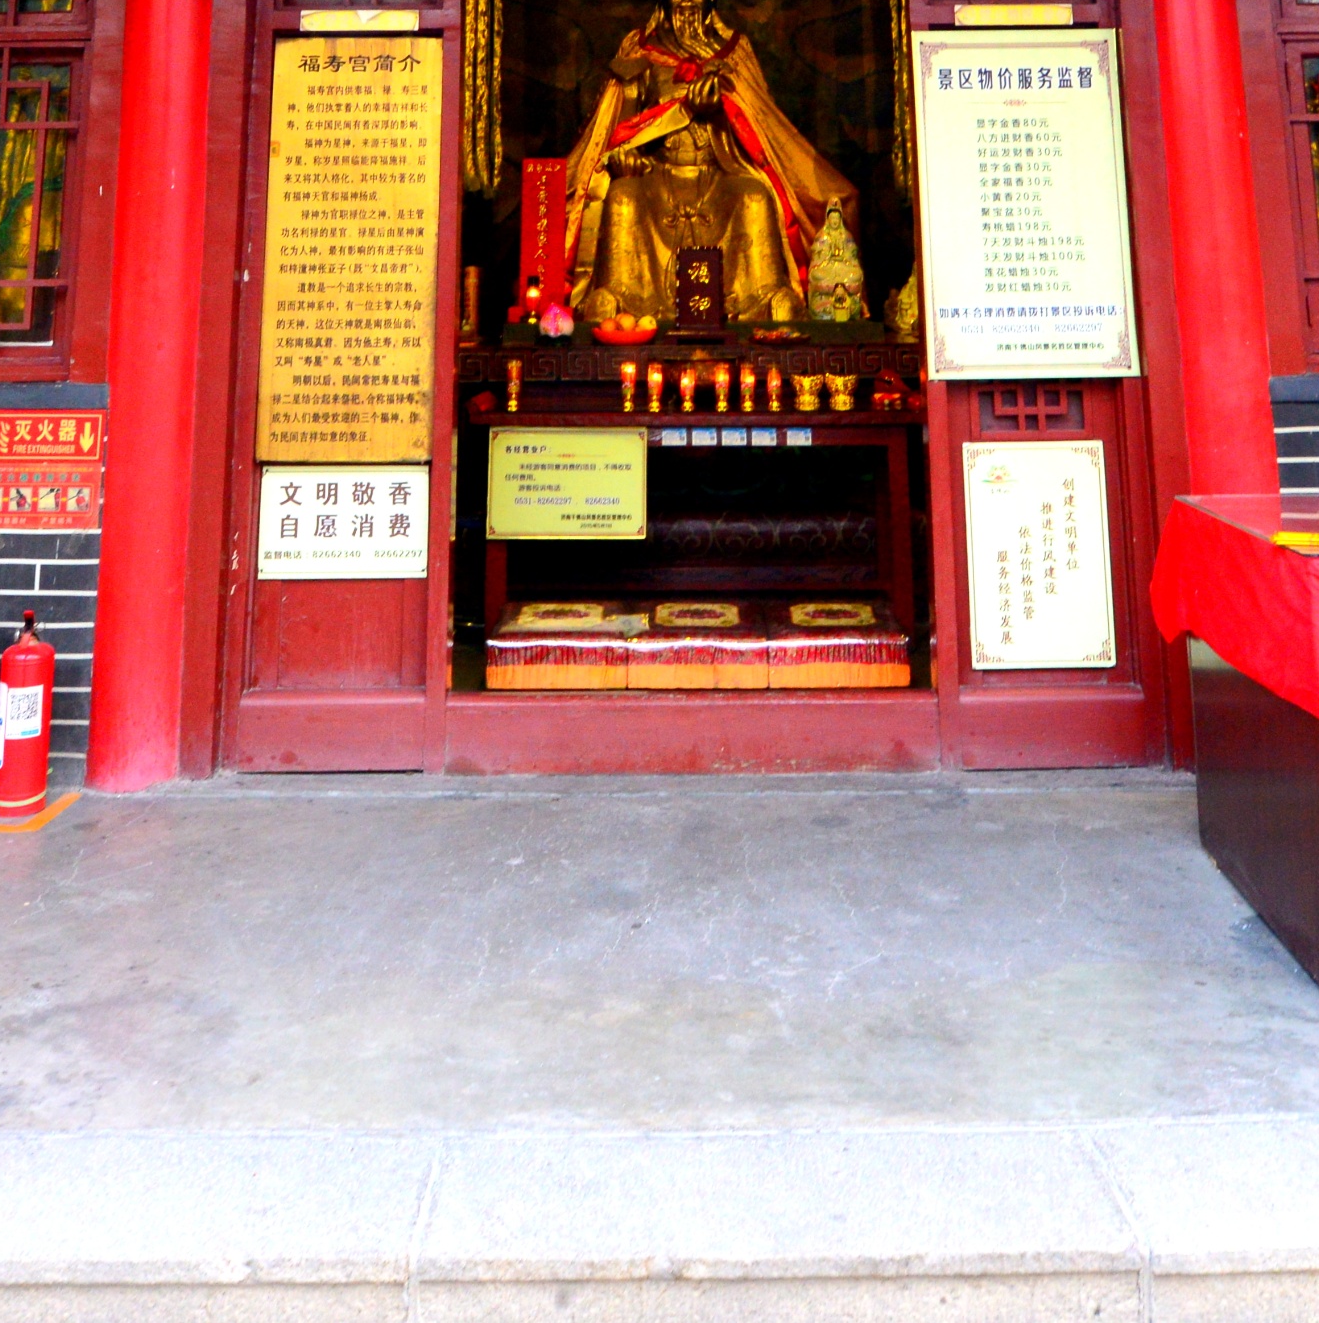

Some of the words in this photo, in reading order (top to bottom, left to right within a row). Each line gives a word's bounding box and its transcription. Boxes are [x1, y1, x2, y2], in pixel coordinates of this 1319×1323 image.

[297, 54, 422, 73] 福寿宫简介
[938, 66, 1094, 91] 景区物价服务监督
[13, 418, 77, 442] 灭火器
[12, 444, 27, 455] FIRE
[280, 482, 412, 506] 文明敬香
[280, 514, 412, 539] 自愿消费
[374, 549, 423, 558] 82662297
